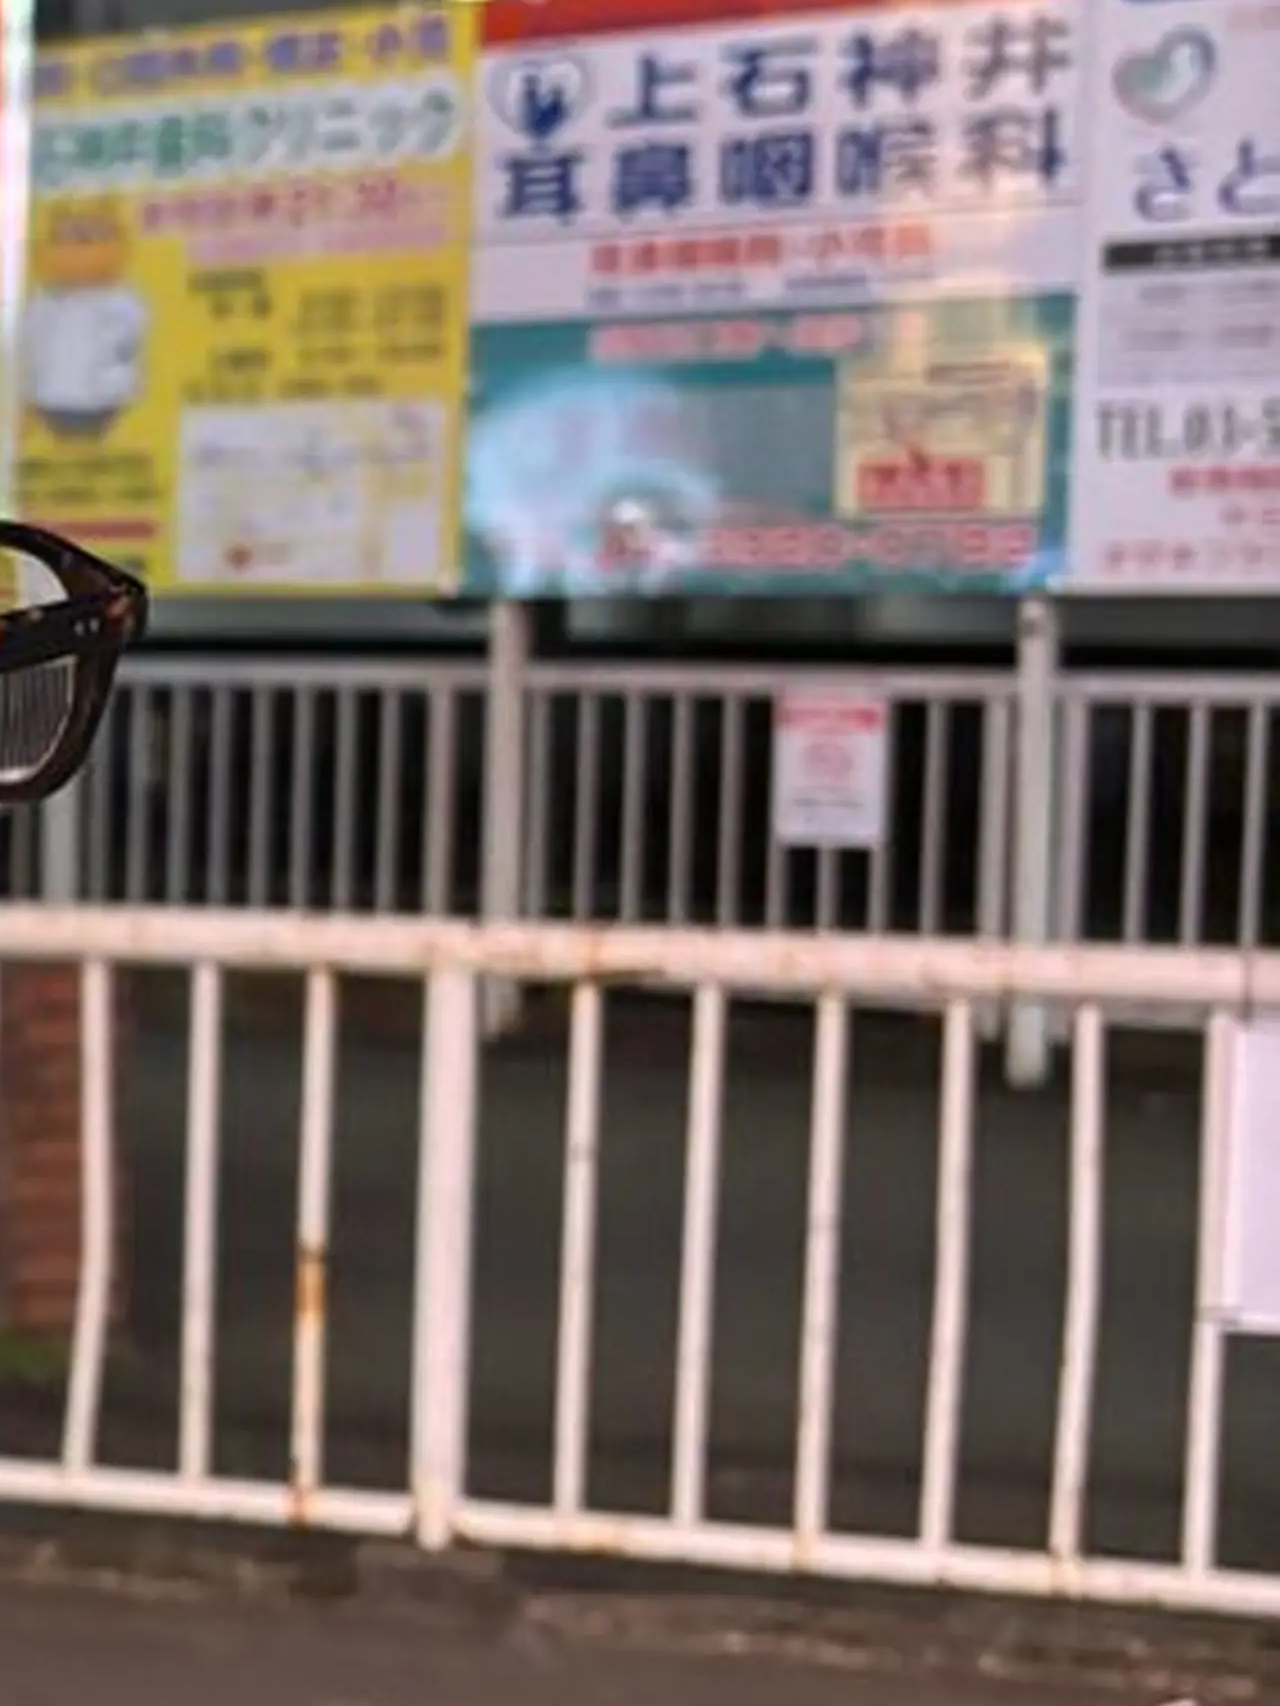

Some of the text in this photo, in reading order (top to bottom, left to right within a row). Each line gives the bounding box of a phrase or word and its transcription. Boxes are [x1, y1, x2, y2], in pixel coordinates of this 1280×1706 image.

[606, 15, 1072, 131] 上石神井
[500, 107, 1066, 223] 耳鼻咽喉科
